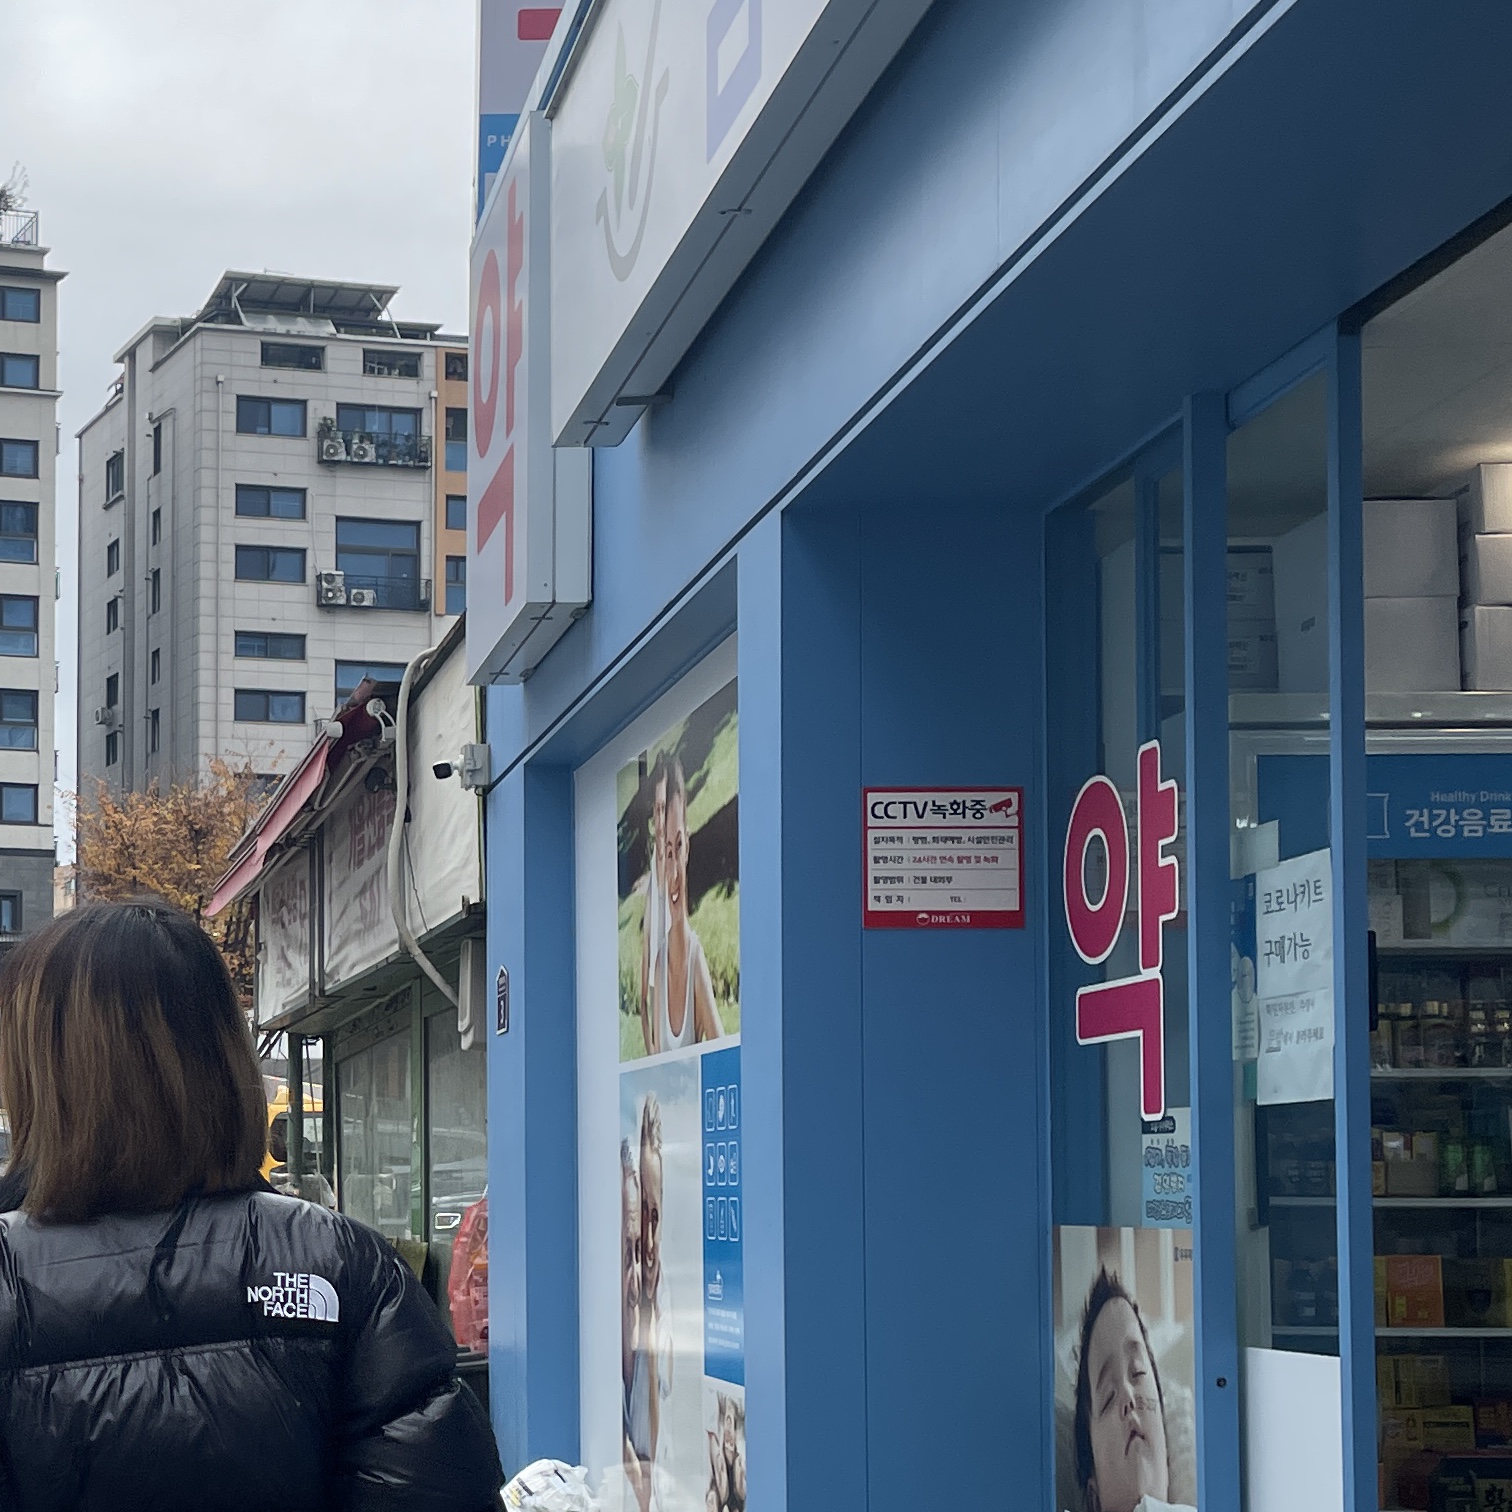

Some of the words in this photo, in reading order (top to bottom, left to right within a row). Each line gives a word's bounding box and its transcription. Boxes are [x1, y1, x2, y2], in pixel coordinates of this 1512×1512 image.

[473, 175, 525, 607] 약
[1404, 808, 1512, 839] 건강음료
[1263, 879, 1324, 916] 코로나키트
[930, 914, 971, 924] DREAM
[1063, 739, 1180, 1122] 약
[1264, 931, 1312, 967] 구매가능
[246, 1285, 308, 1304] NORTH
[272, 1271, 309, 1289] THE
[263, 1301, 308, 1319] FACE
